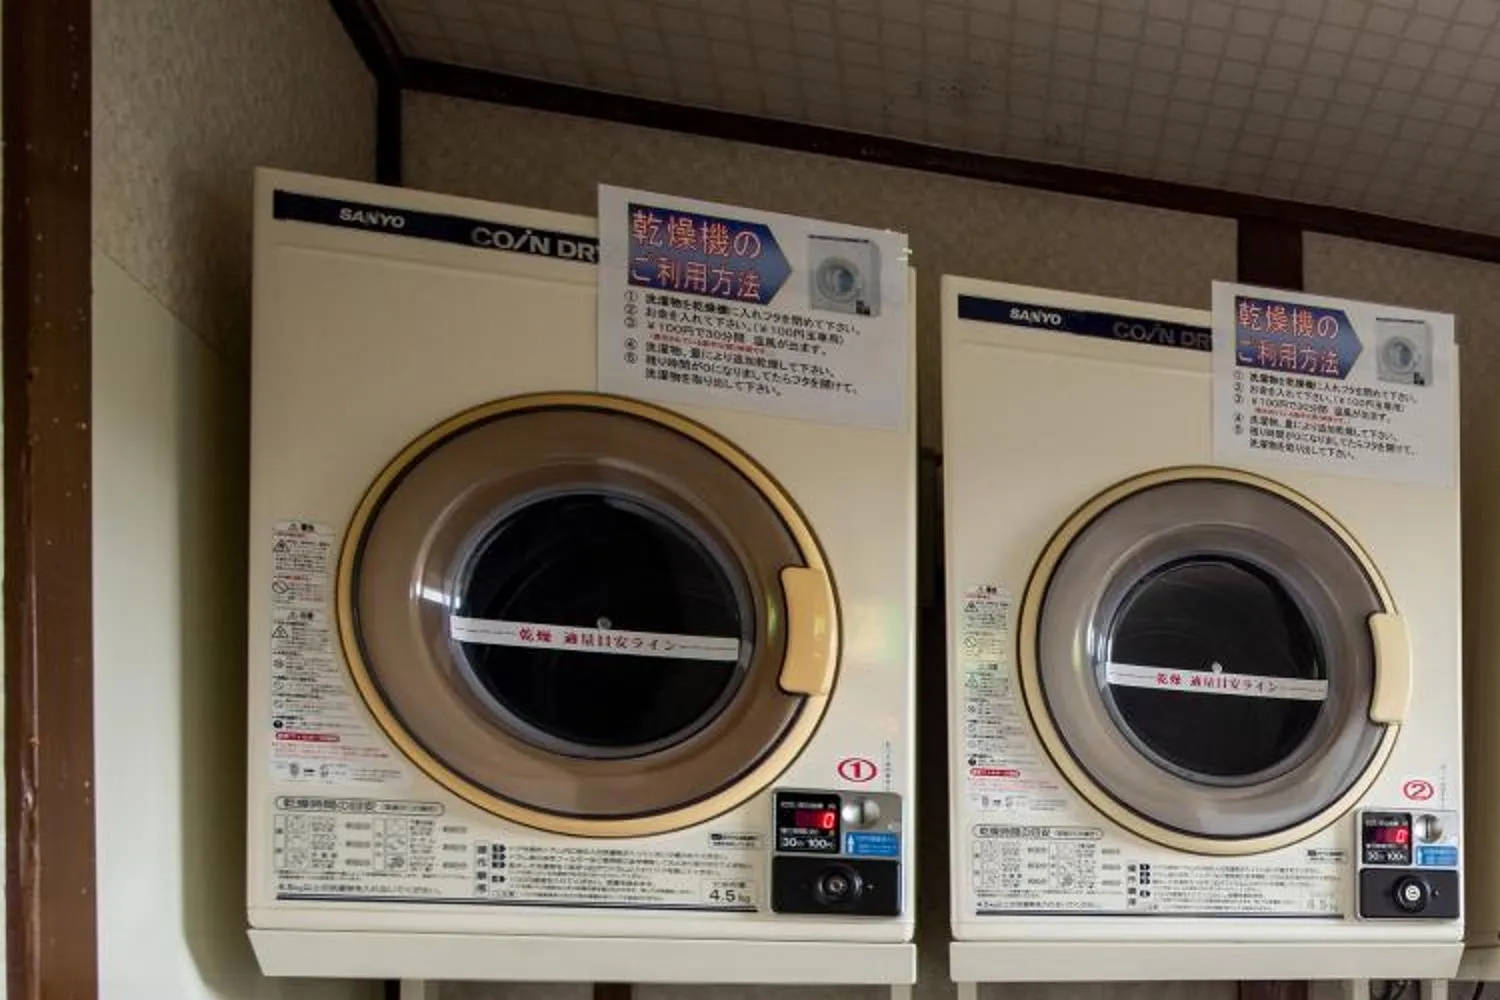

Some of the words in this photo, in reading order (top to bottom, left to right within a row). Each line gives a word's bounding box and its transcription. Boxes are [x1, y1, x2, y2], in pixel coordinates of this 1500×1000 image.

[340, 208, 405, 228] SANYO
[632, 209, 761, 258] 乾燥機の
[557, 239, 599, 263] DR
[632, 255, 761, 300] ご利用方法
[1010, 307, 1061, 325] SANYO
[1239, 301, 1339, 339] 乾燥機の
[1239, 340, 1339, 375] ご利用方法
[518, 626, 552, 644] 乾燥
[823, 812, 835, 829] 0
[1396, 829, 1408, 843] 0
[709, 890, 736, 903] 4.5
